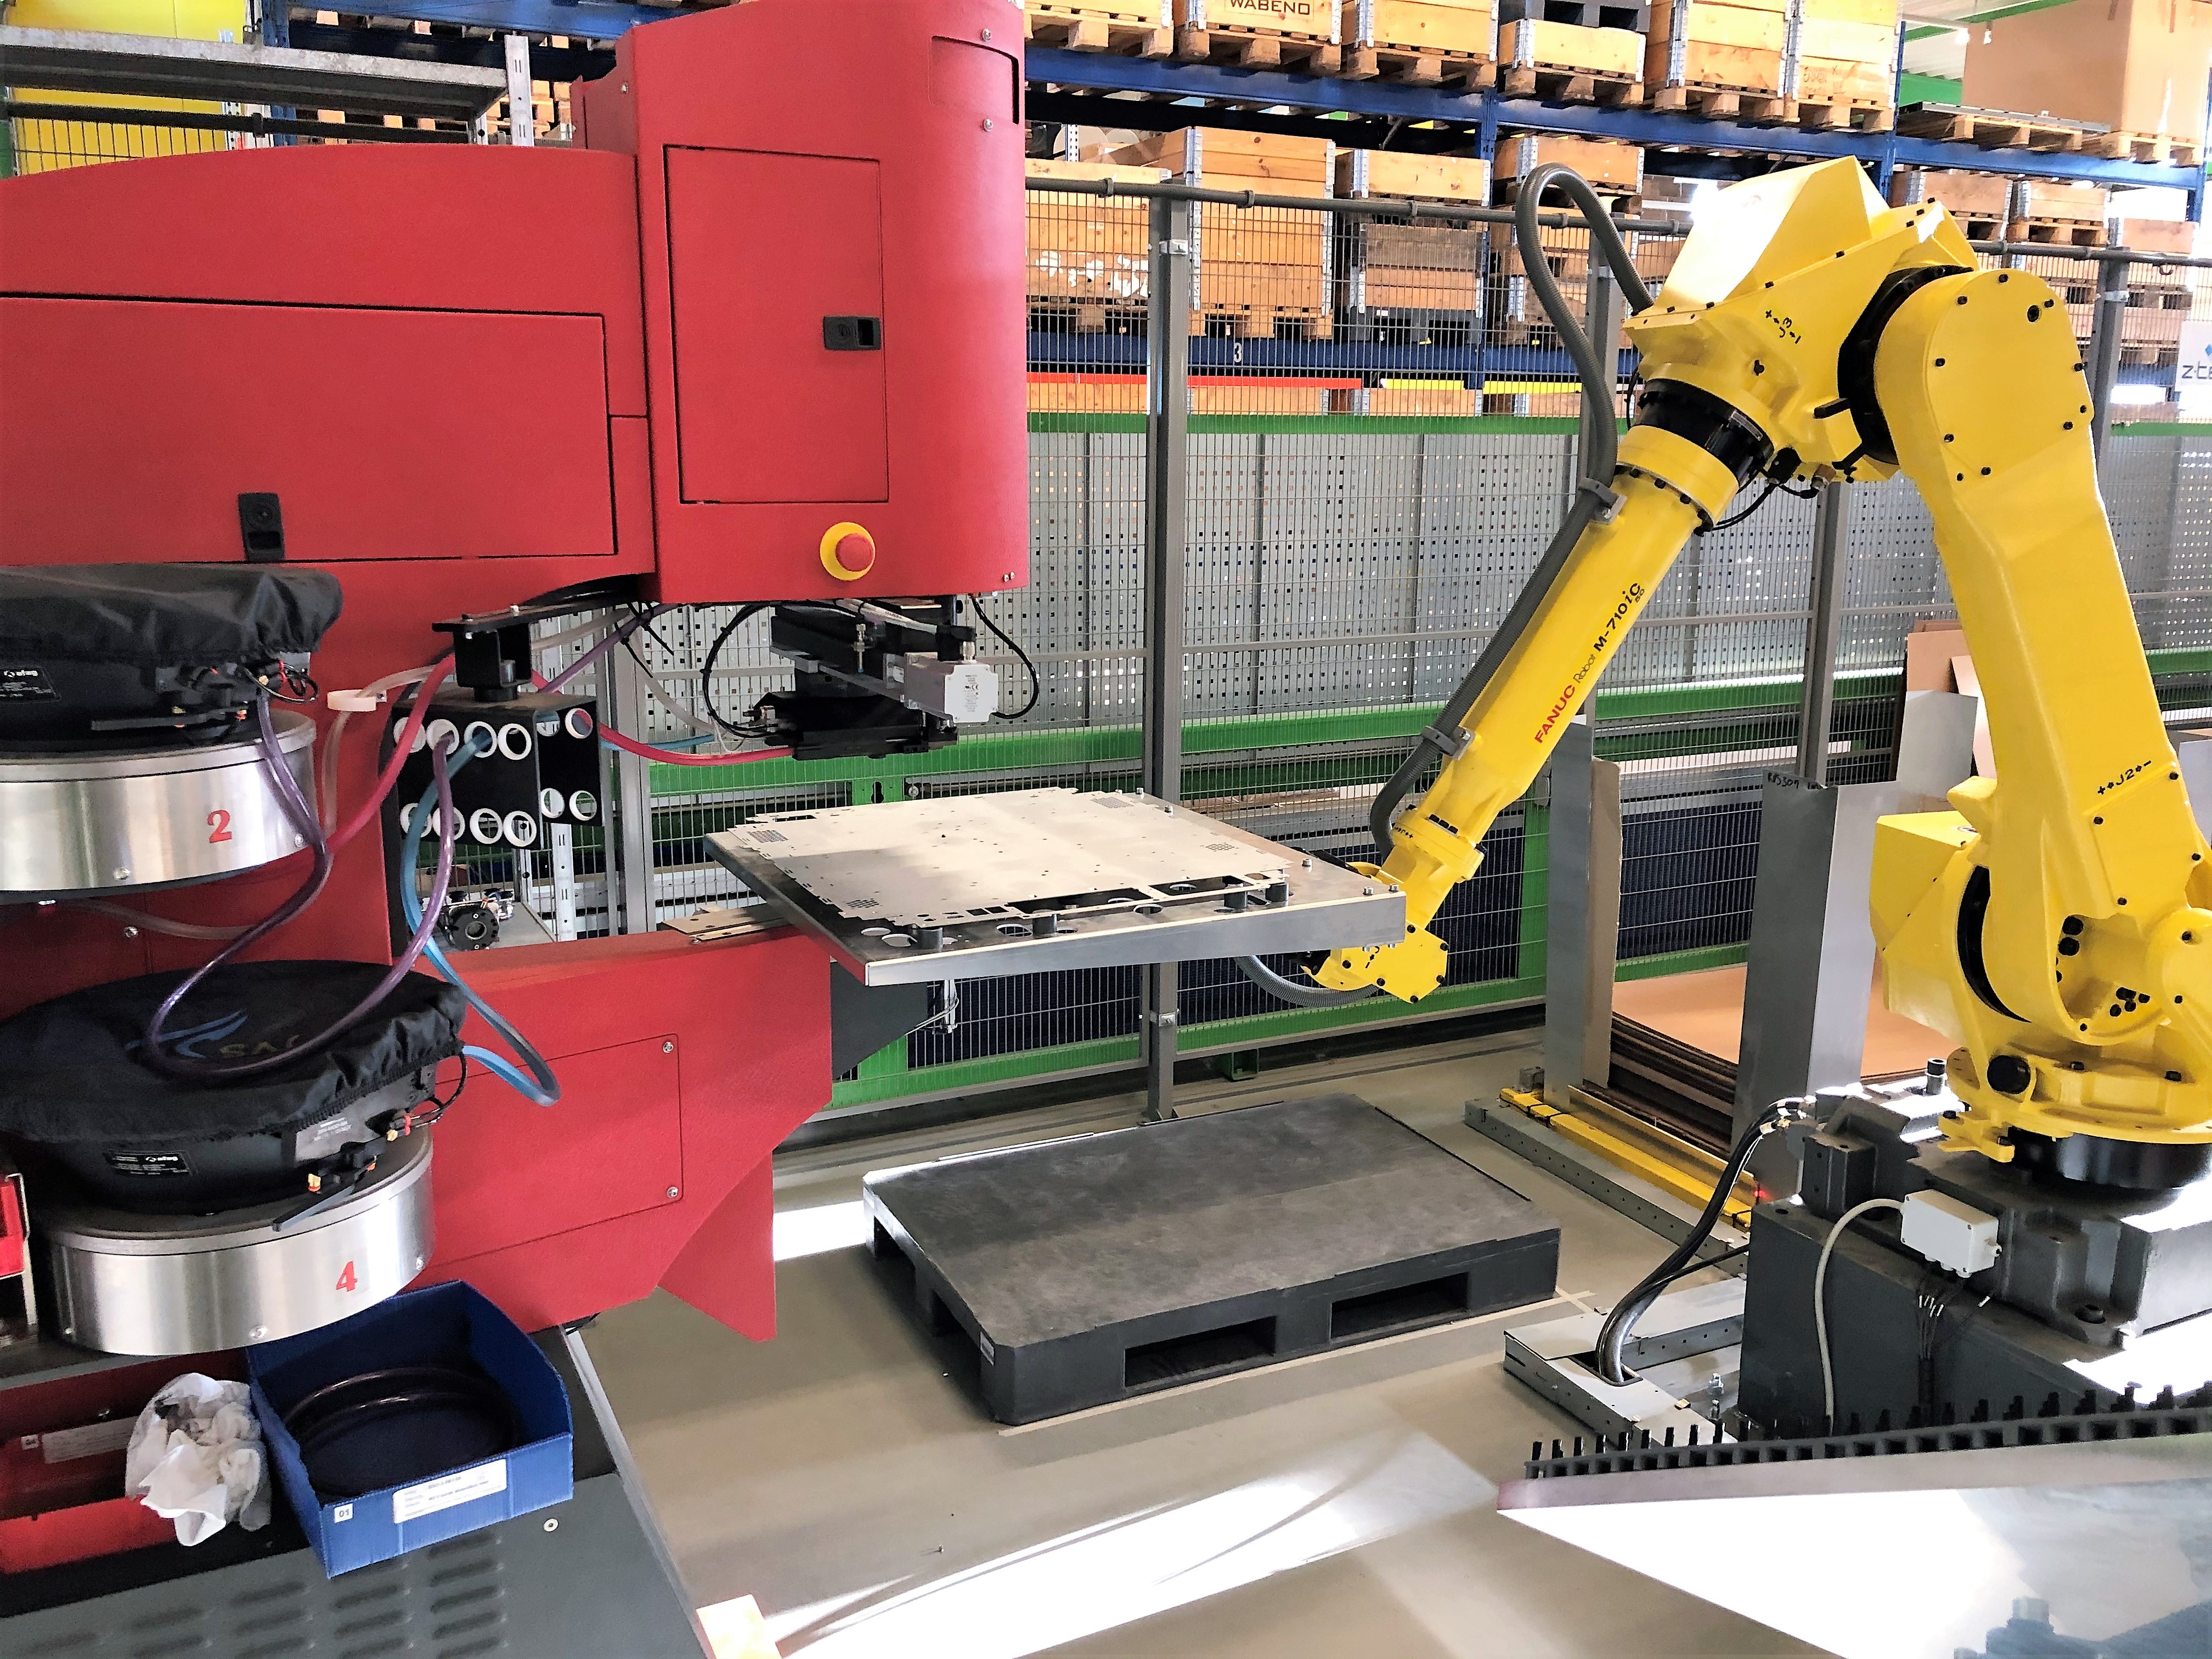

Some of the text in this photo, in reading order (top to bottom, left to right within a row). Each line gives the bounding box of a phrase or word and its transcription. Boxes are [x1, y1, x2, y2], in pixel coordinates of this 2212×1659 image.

[1234, 342, 1242, 363] 3
[1534, 685, 1575, 744] FANUC
[1573, 653, 1596, 684] Robot
[207, 810, 232, 843] 2
[336, 1260, 358, 1291] 4
[338, 1509, 350, 1517] 01
